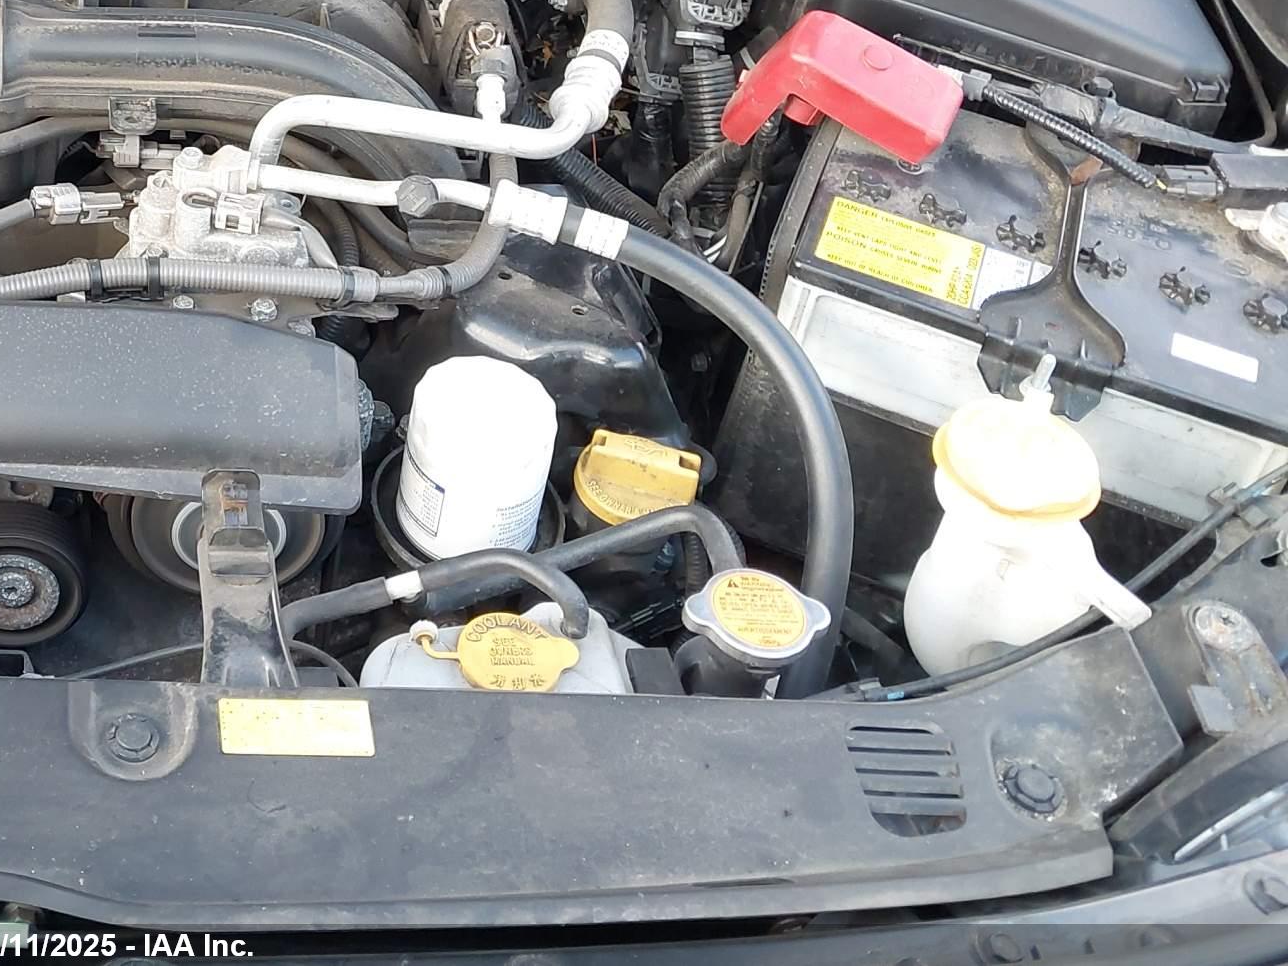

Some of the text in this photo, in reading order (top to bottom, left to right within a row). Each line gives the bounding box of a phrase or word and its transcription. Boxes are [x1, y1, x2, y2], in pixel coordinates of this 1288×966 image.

[836, 200, 878, 218] DANGER
[825, 230, 867, 249] POISON
[465, 613, 549, 643] COOLANT
[489, 656, 537, 666] MANUAL
